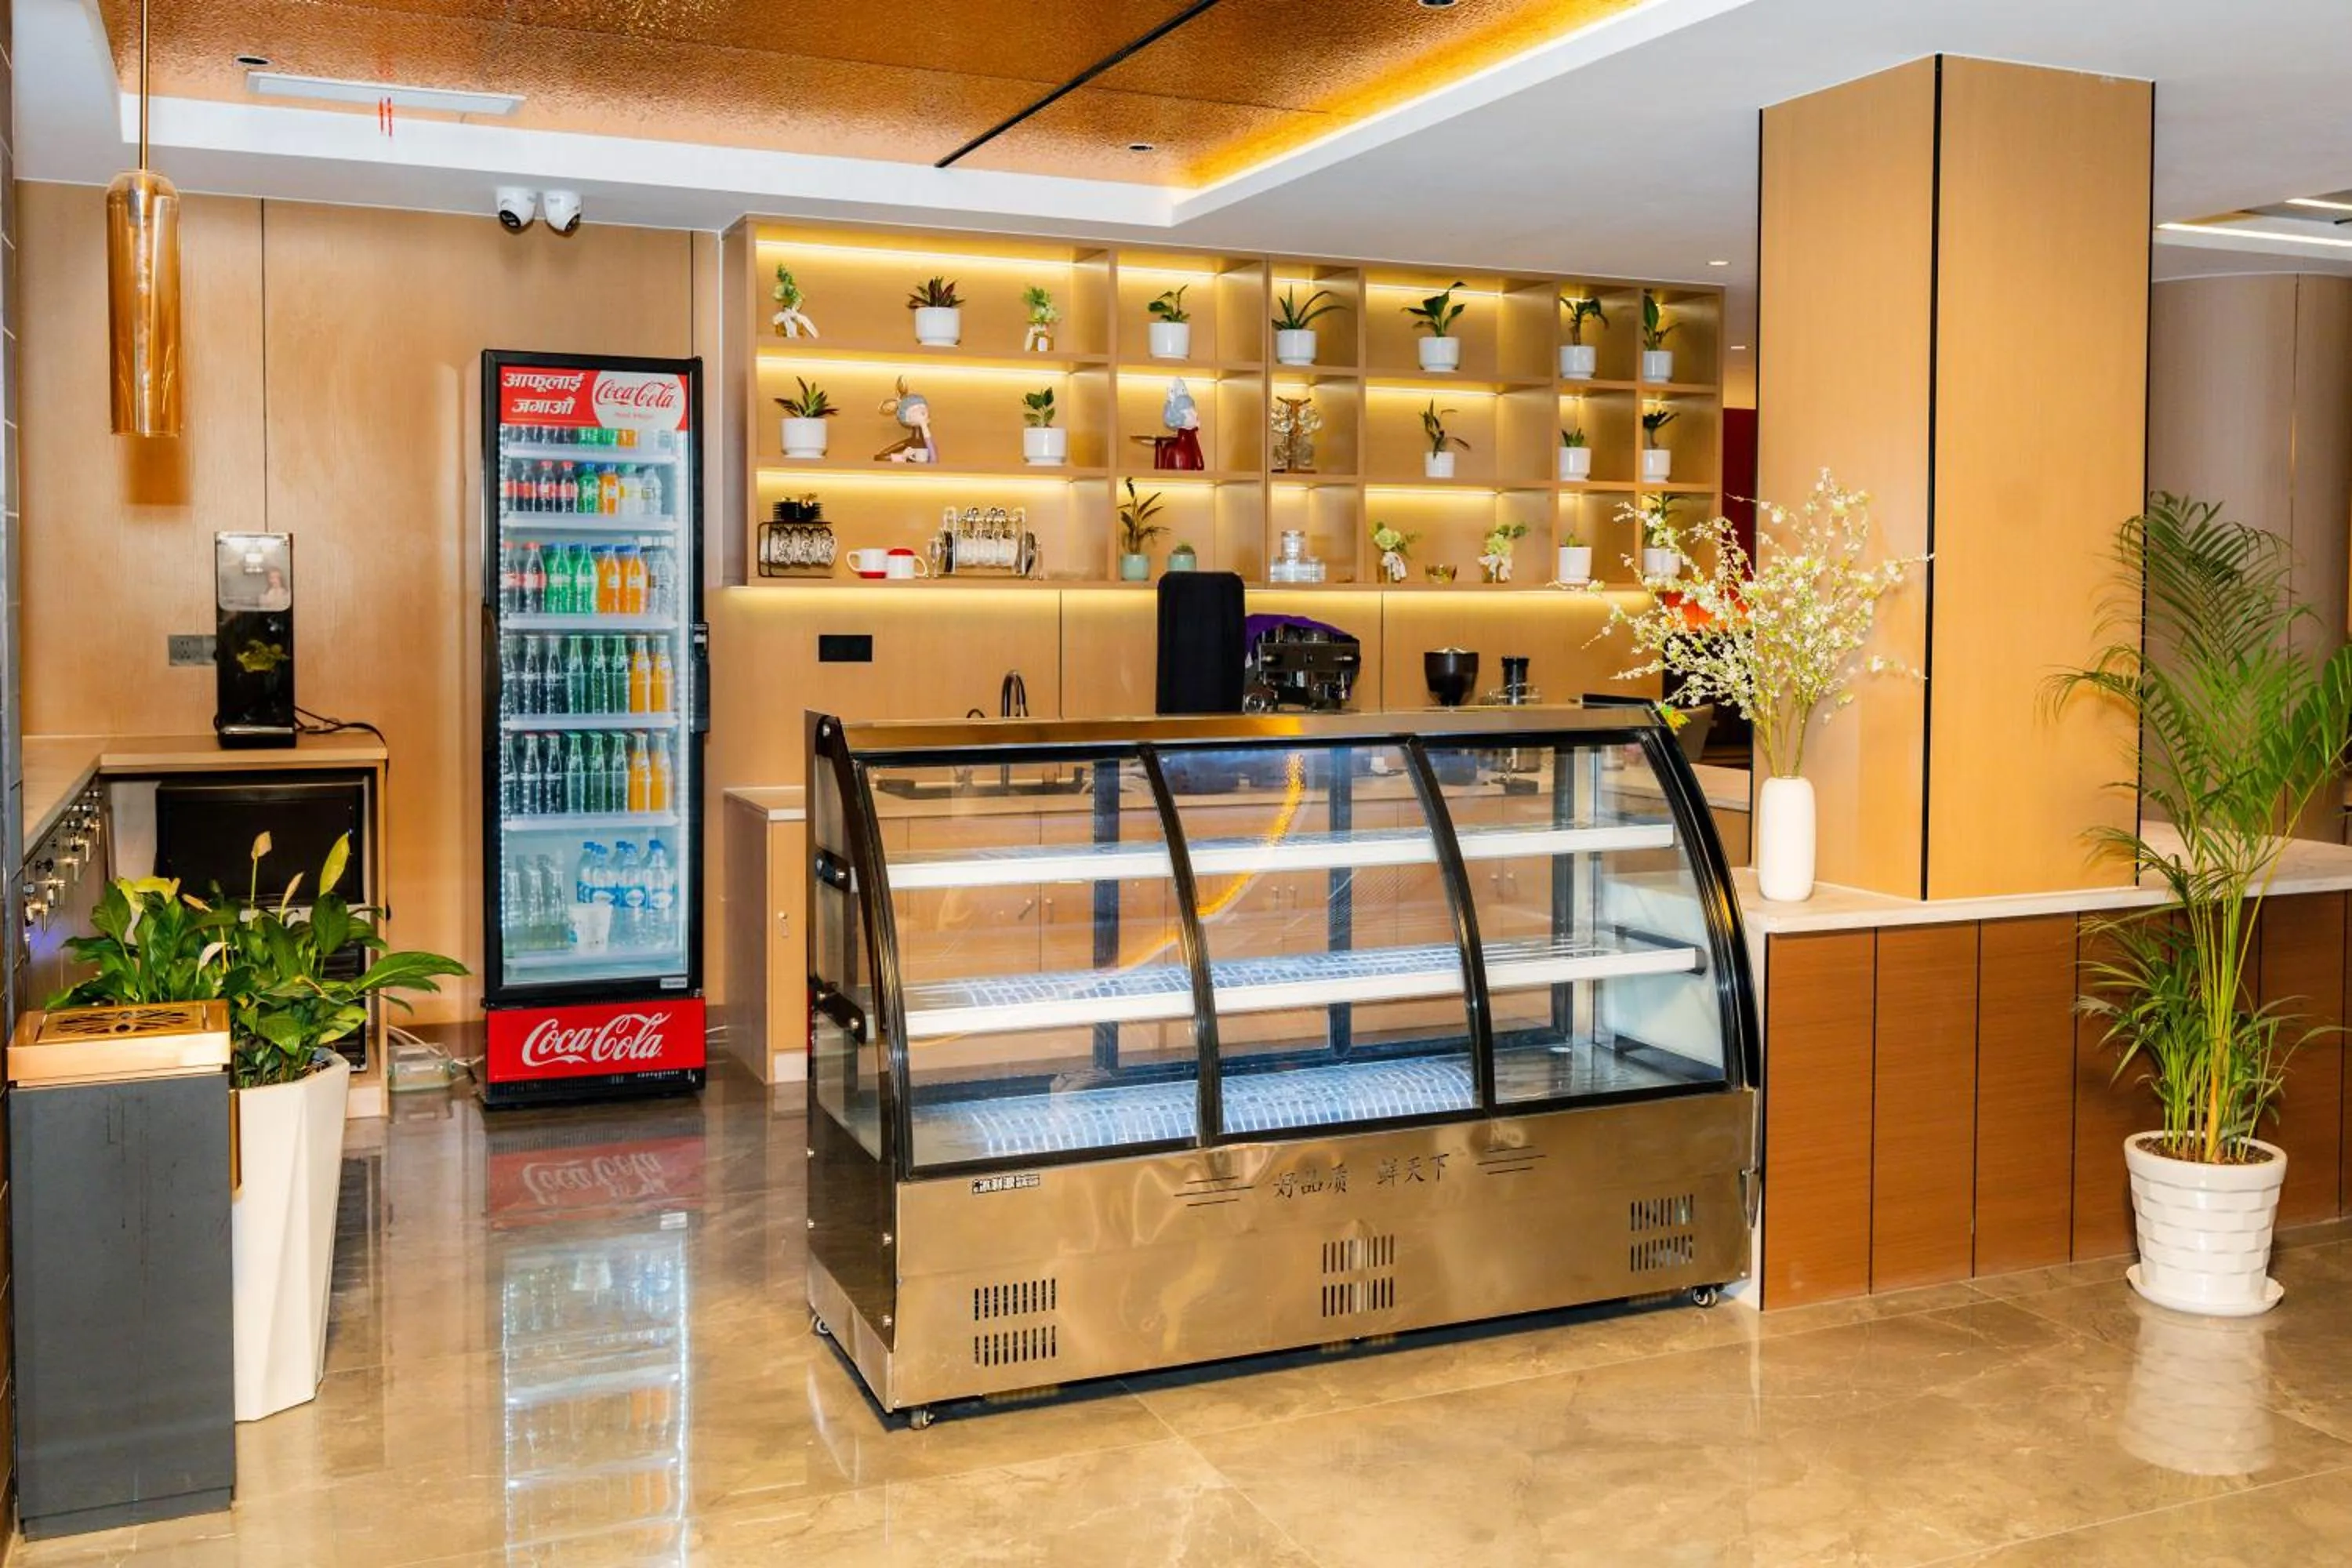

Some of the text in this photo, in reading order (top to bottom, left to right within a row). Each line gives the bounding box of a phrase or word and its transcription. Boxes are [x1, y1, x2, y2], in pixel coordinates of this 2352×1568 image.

[521, 1012, 672, 1067] Coca-Cola
[1273, 1153, 1450, 1199] 好品质 鲜天下
